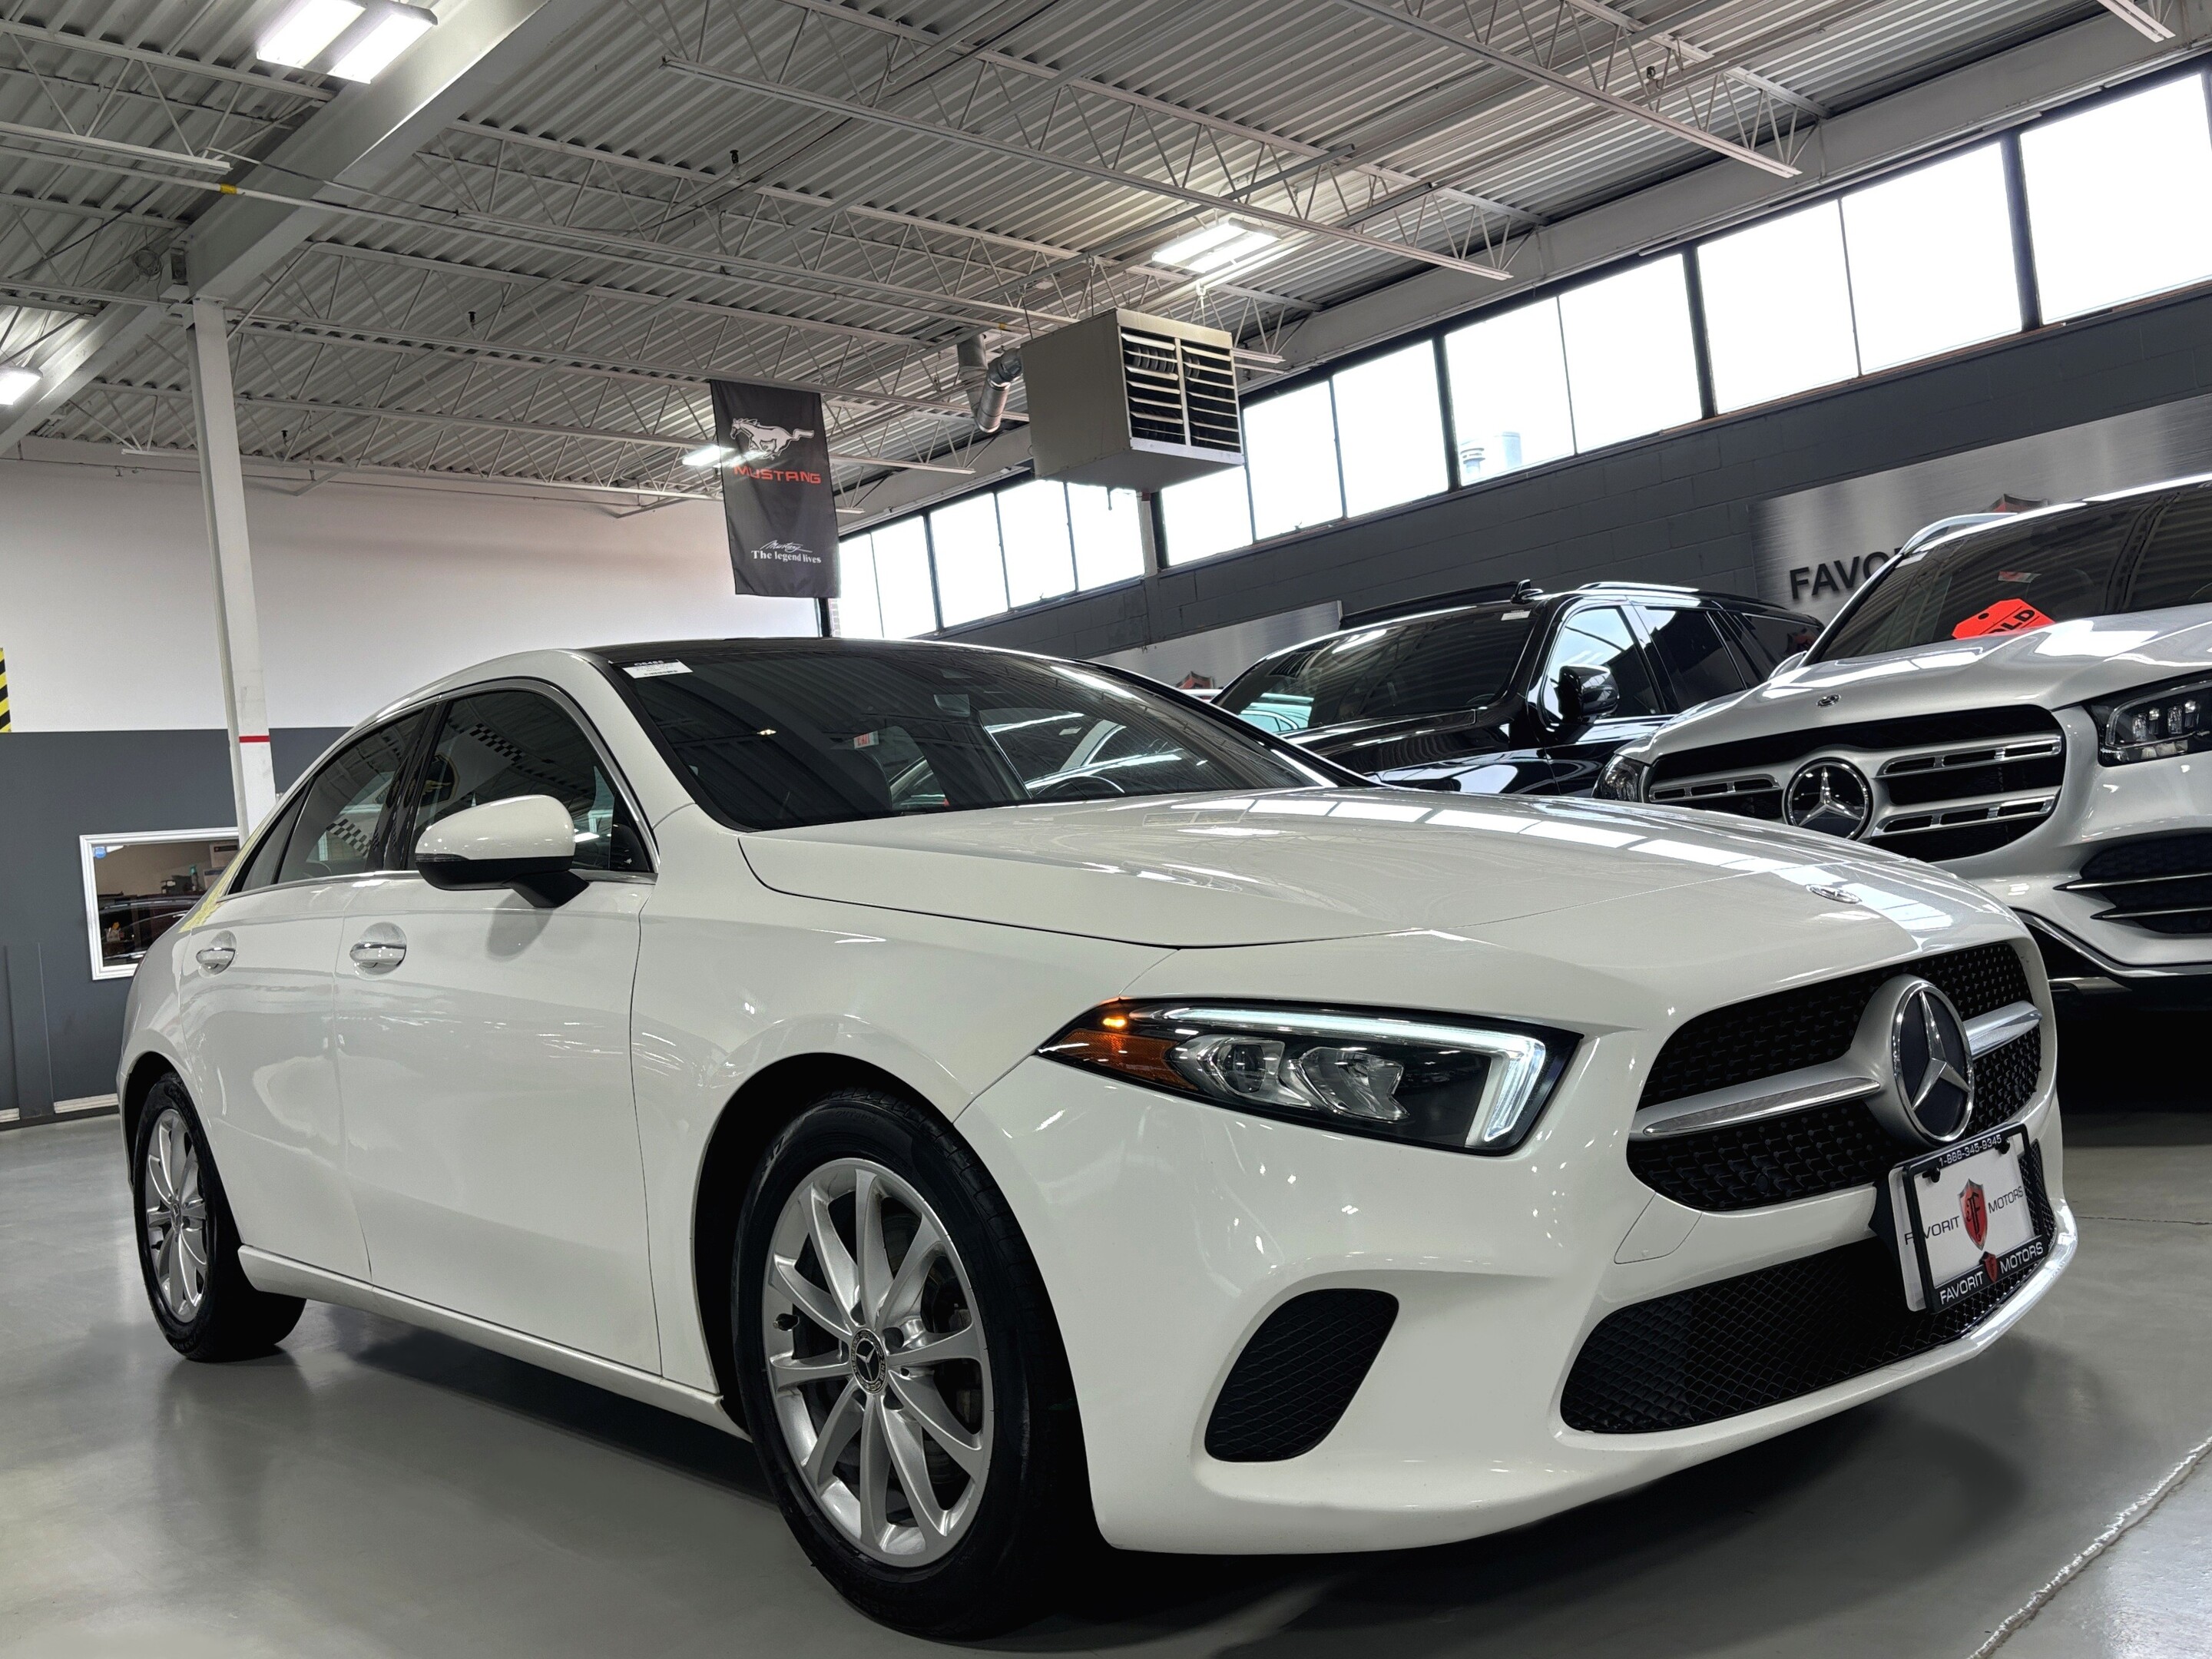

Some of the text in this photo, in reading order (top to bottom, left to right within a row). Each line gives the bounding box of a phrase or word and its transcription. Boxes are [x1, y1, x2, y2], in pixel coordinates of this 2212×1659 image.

[733, 464, 821, 484] MUSTANG
[751, 550, 822, 564] The legend lives
[1790, 546, 1903, 600] FAVO
[1939, 1134, 2002, 1167] 1-888-345-9345
[1904, 1185, 2024, 1245] FVORIT MOTORS
[1939, 1241, 2044, 1305] FAVORIT MOTORS
